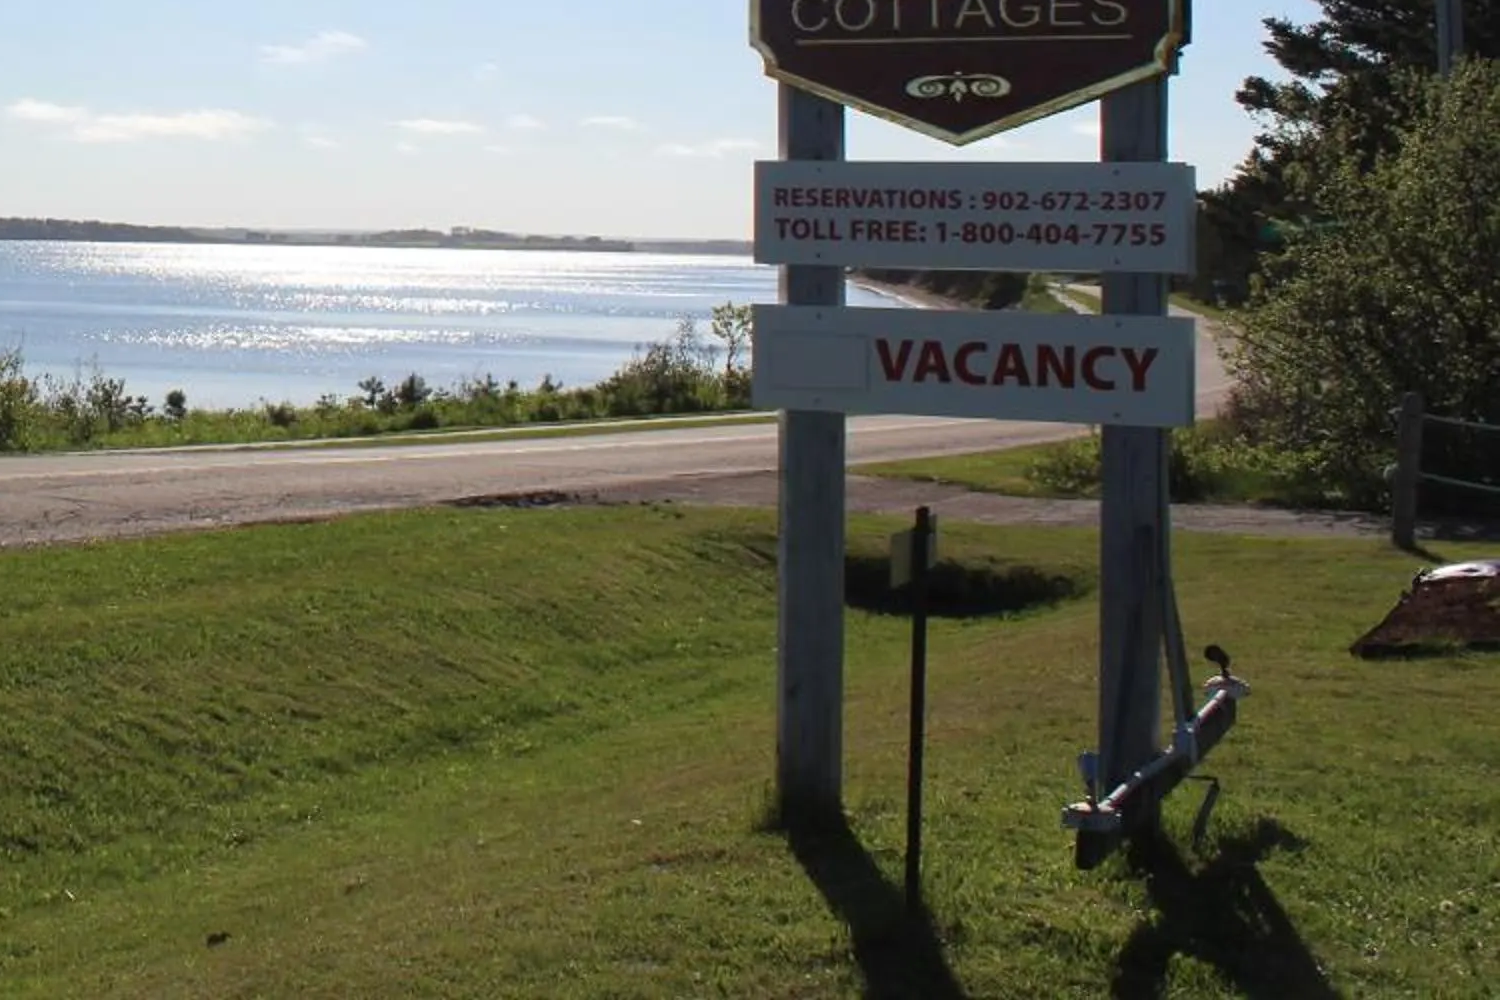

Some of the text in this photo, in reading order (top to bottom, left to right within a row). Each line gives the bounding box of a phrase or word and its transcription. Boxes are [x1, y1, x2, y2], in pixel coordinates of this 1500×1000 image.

[774, 217, 1167, 246] TOLL FREE: 1-800-404-7755
[876, 338, 1158, 392] VACANCY
